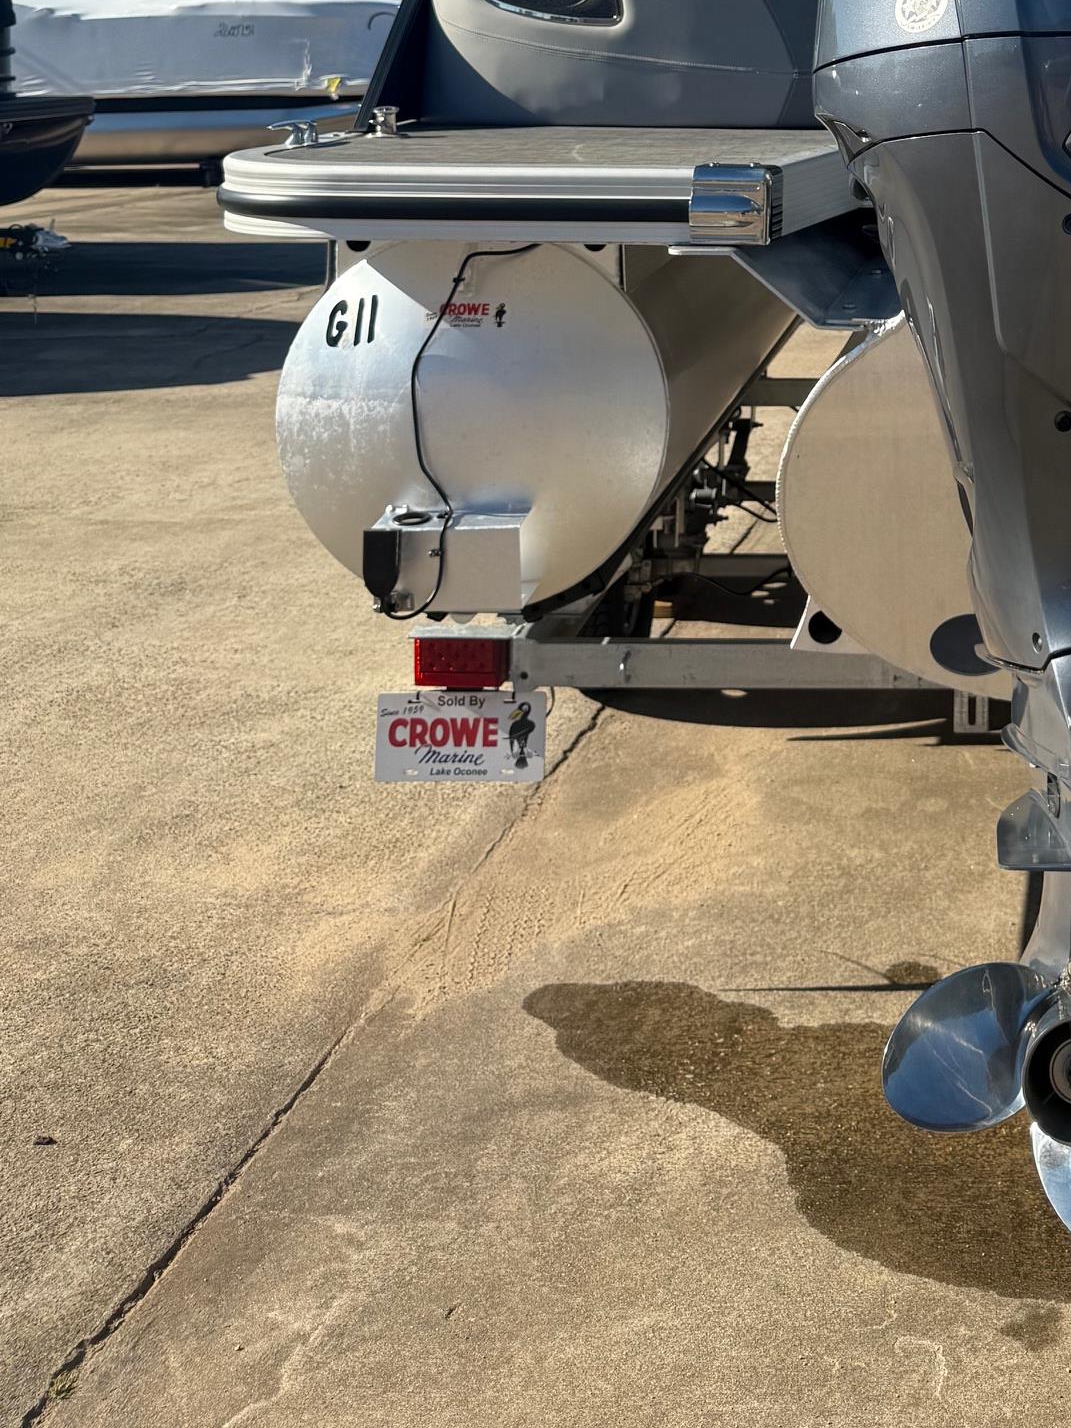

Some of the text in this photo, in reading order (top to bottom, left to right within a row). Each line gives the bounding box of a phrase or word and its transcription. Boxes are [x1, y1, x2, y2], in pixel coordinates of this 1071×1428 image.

[437, 695, 486, 709] Sold By
[388, 717, 499, 748] CROWE
[414, 744, 486, 766] Marine
[429, 767, 488, 776] Lake Oconee
